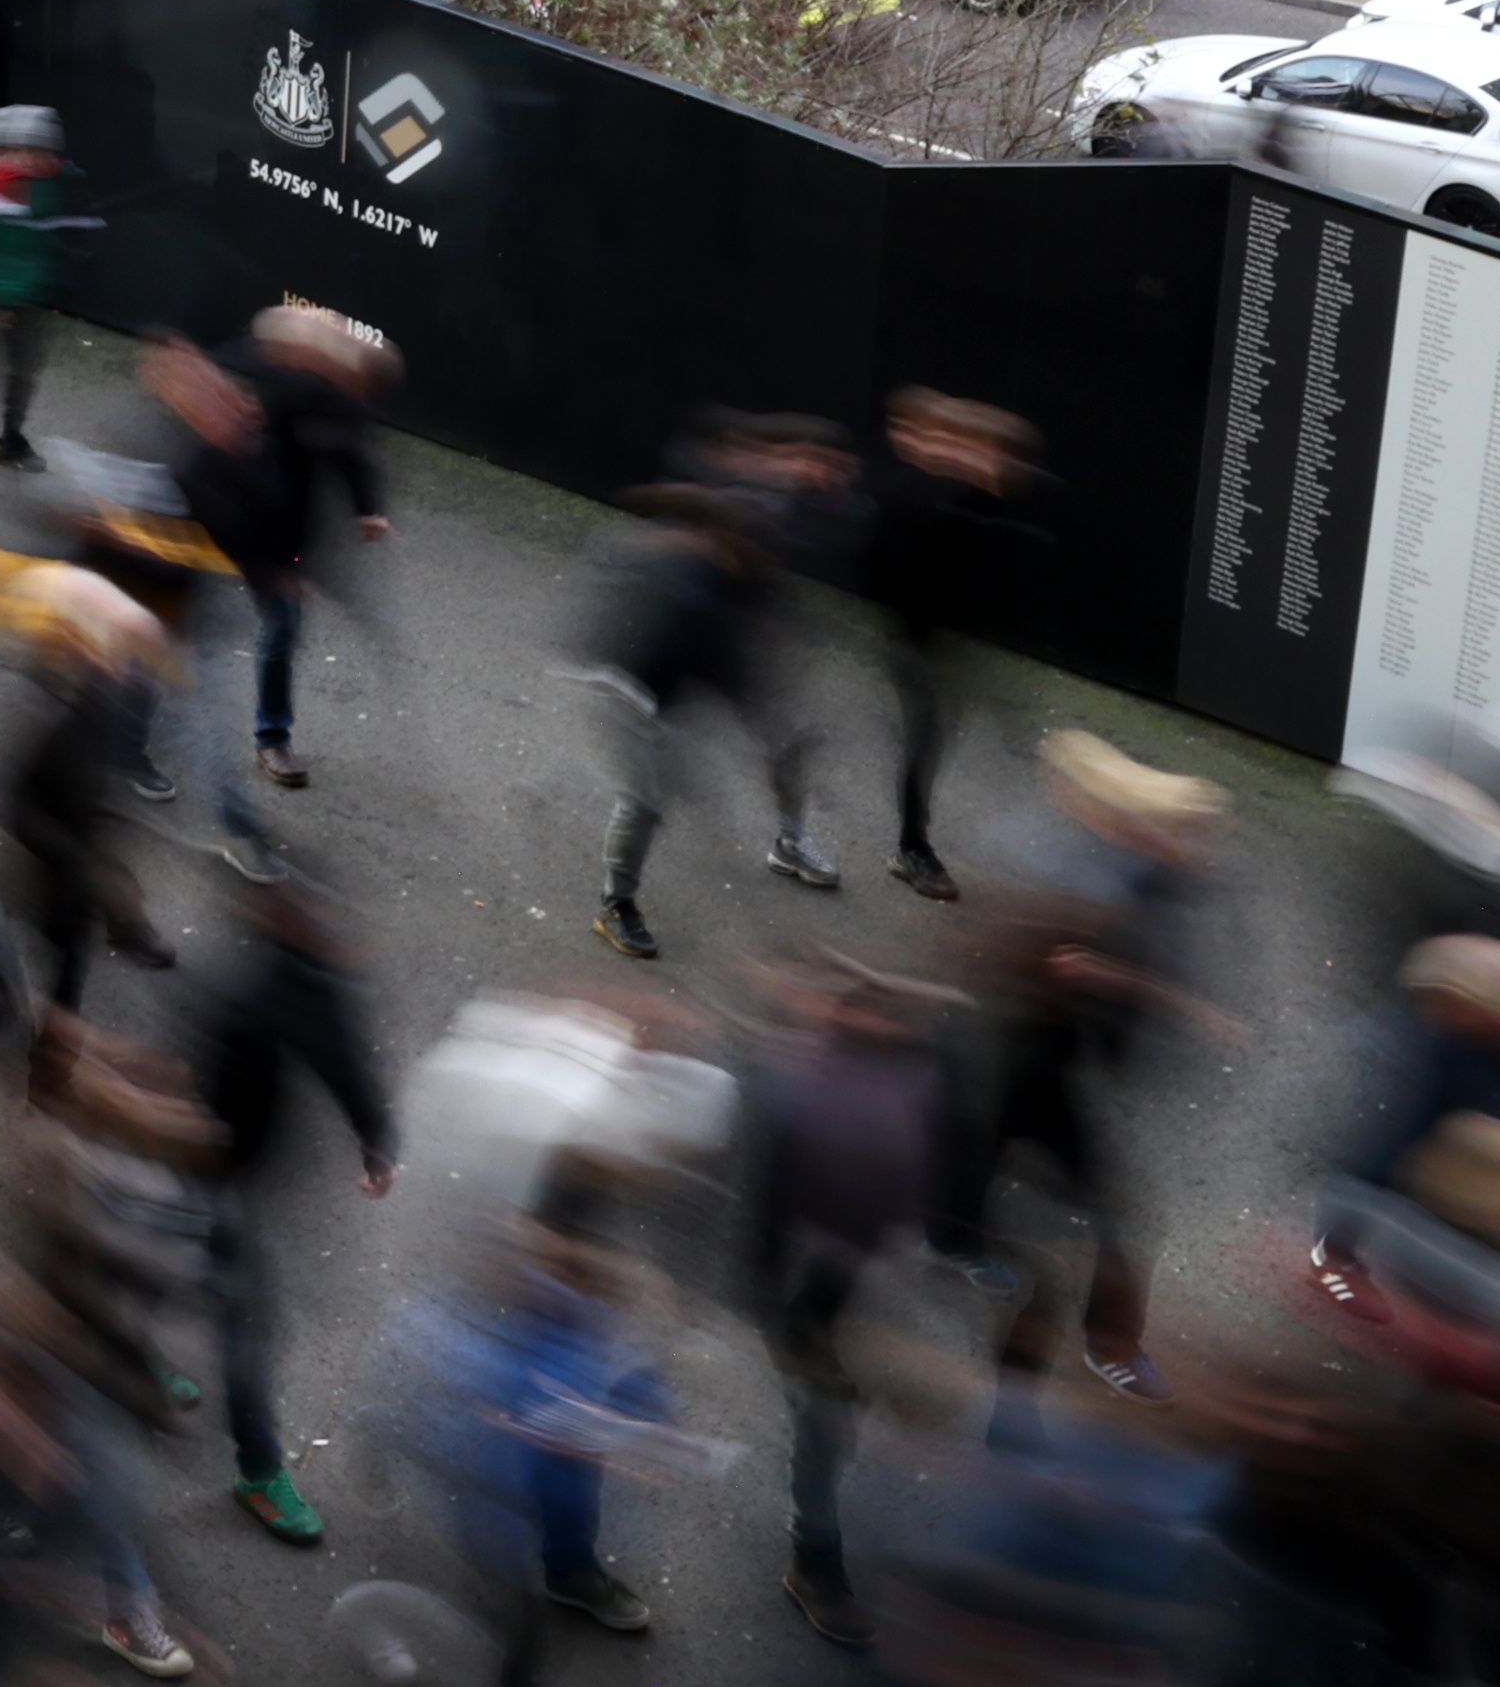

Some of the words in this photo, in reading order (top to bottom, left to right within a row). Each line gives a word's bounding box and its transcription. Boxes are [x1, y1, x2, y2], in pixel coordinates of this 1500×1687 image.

[250, 158, 318, 199] 54.9756°
[324, 188, 344, 215] N,
[352, 199, 412, 235] 1.6217°
[418, 224, 439, 248] W
[347, 317, 384, 349] 1892
